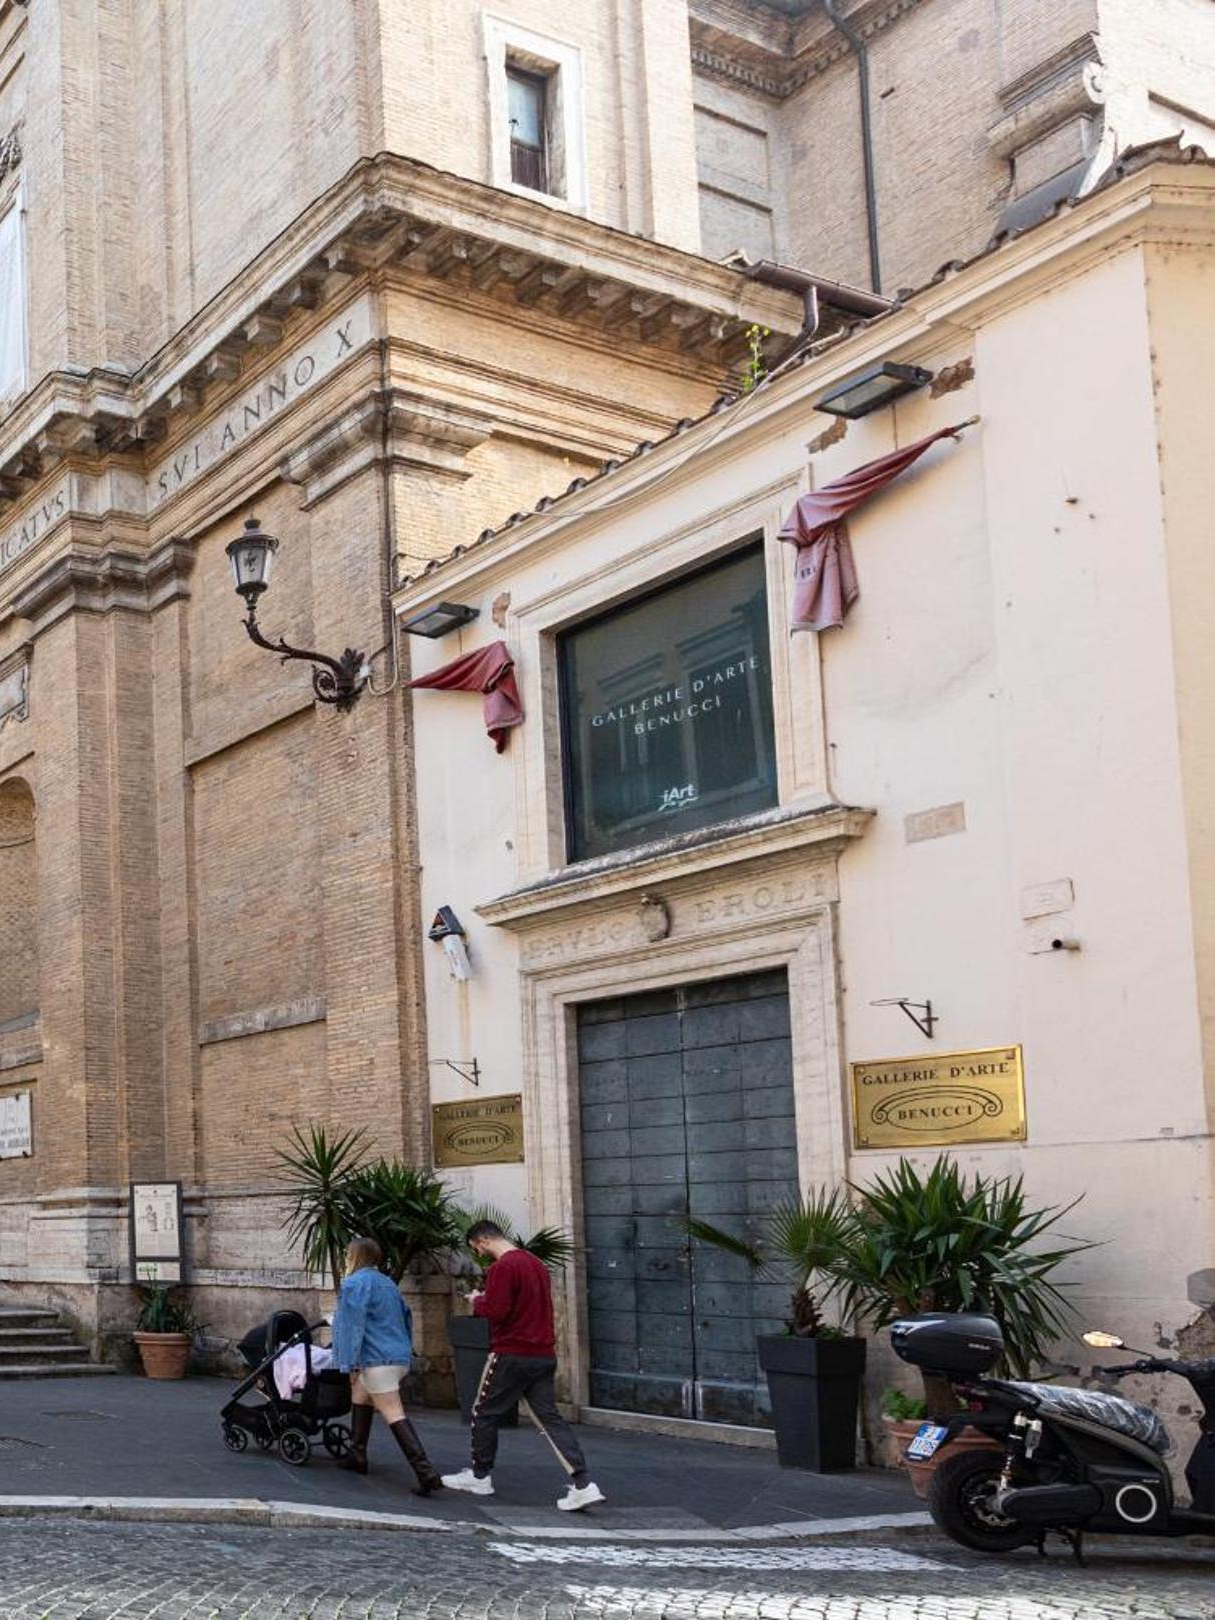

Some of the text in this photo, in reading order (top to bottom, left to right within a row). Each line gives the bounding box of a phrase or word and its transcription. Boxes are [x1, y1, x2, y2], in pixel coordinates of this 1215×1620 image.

[158, 445, 200, 498] SVI
[221, 355, 315, 450] ANNO
[336, 319, 353, 358] X
[592, 656, 759, 727] GALLERIE D'ARTE
[634, 695, 720, 735] BENUCCI
[696, 873, 826, 922] EROLI
[862, 1062, 1009, 1086] GALLERIE D'ARTE
[898, 1108, 972, 1120] BENUCCI
